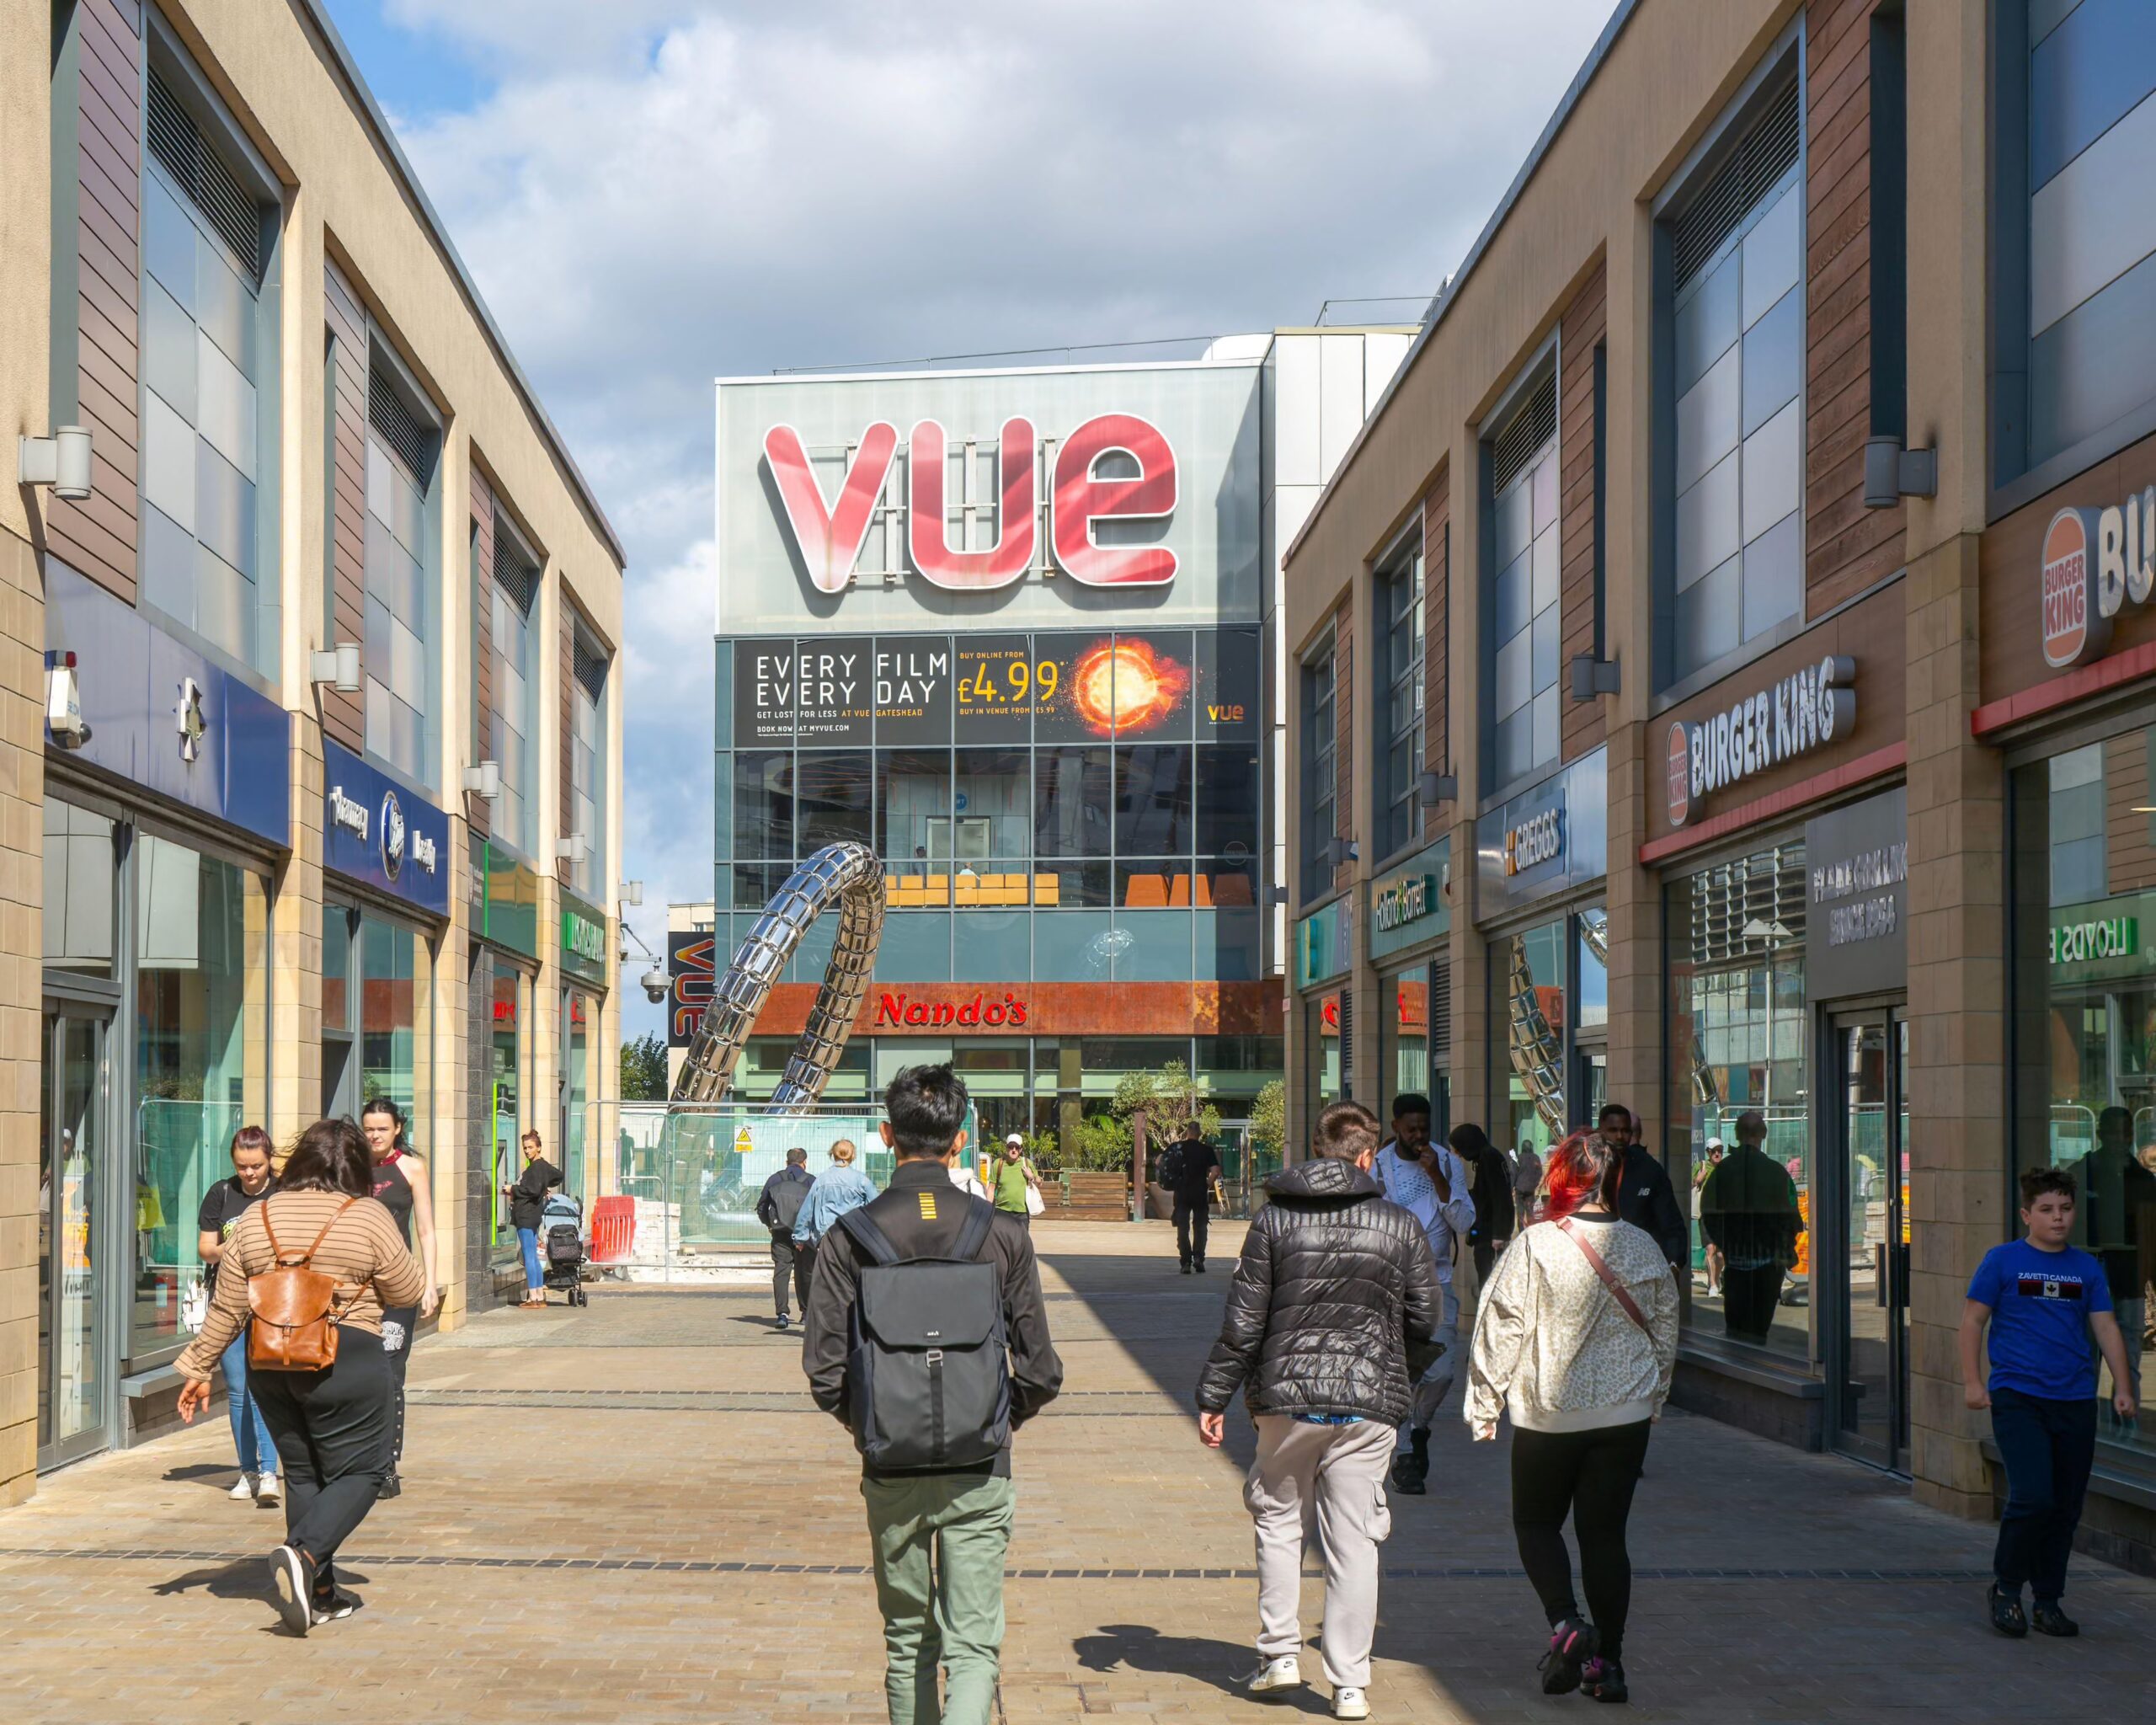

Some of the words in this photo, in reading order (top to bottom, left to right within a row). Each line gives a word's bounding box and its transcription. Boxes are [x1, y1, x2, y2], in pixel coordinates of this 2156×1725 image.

[2045, 553, 2084, 596] BURGER
[2045, 584, 2084, 637] KING
[757, 654, 857, 679] EVERY
[877, 653, 947, 677] FILM
[757, 681, 857, 706] EVERY
[877, 680, 936, 704] DAY
[757, 710, 772, 719] GET
[774, 710, 794, 718] LOST
[800, 709, 815, 718] FOR
[818, 708, 837, 718] LESS
[841, 708, 851, 717] AT
[854, 708, 870, 718] VUE
[876, 708, 923, 717] GATESHEAD
[1691, 690, 1769, 798] BURGER
[1775, 655, 1834, 762] KING
[1669, 773, 1687, 805] KING
[1515, 809, 1559, 872] GREGGS
[1375, 883, 1399, 932] Holland
[1402, 873, 1427, 921] Barrett
[874, 993, 1027, 1027] Nando's
[2049, 1274, 2083, 1284] CANADA
